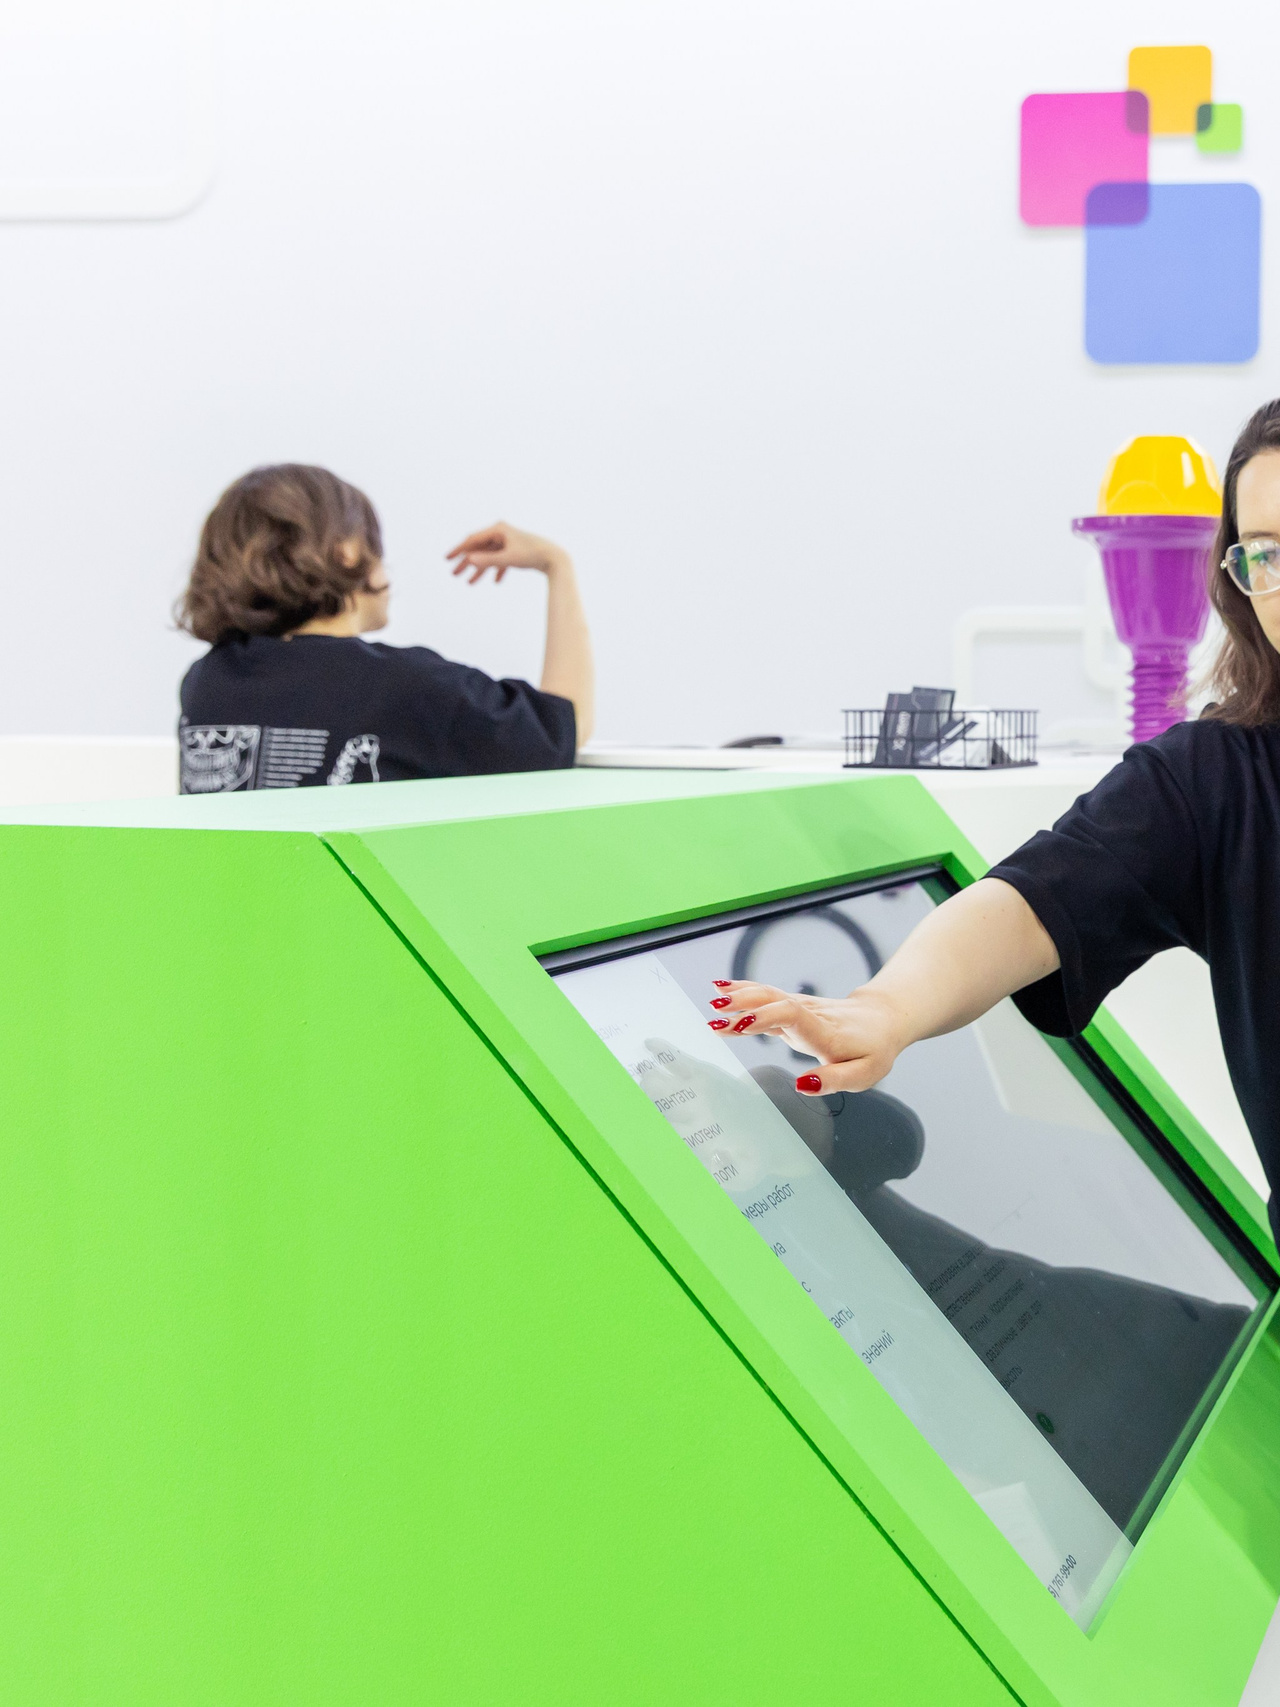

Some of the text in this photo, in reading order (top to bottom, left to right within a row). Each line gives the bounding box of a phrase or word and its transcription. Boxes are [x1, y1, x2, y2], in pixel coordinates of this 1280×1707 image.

[766, 1182, 796, 1210] работ
[828, 1305, 855, 1329] акты
[861, 1328, 896, 1365] знаний
